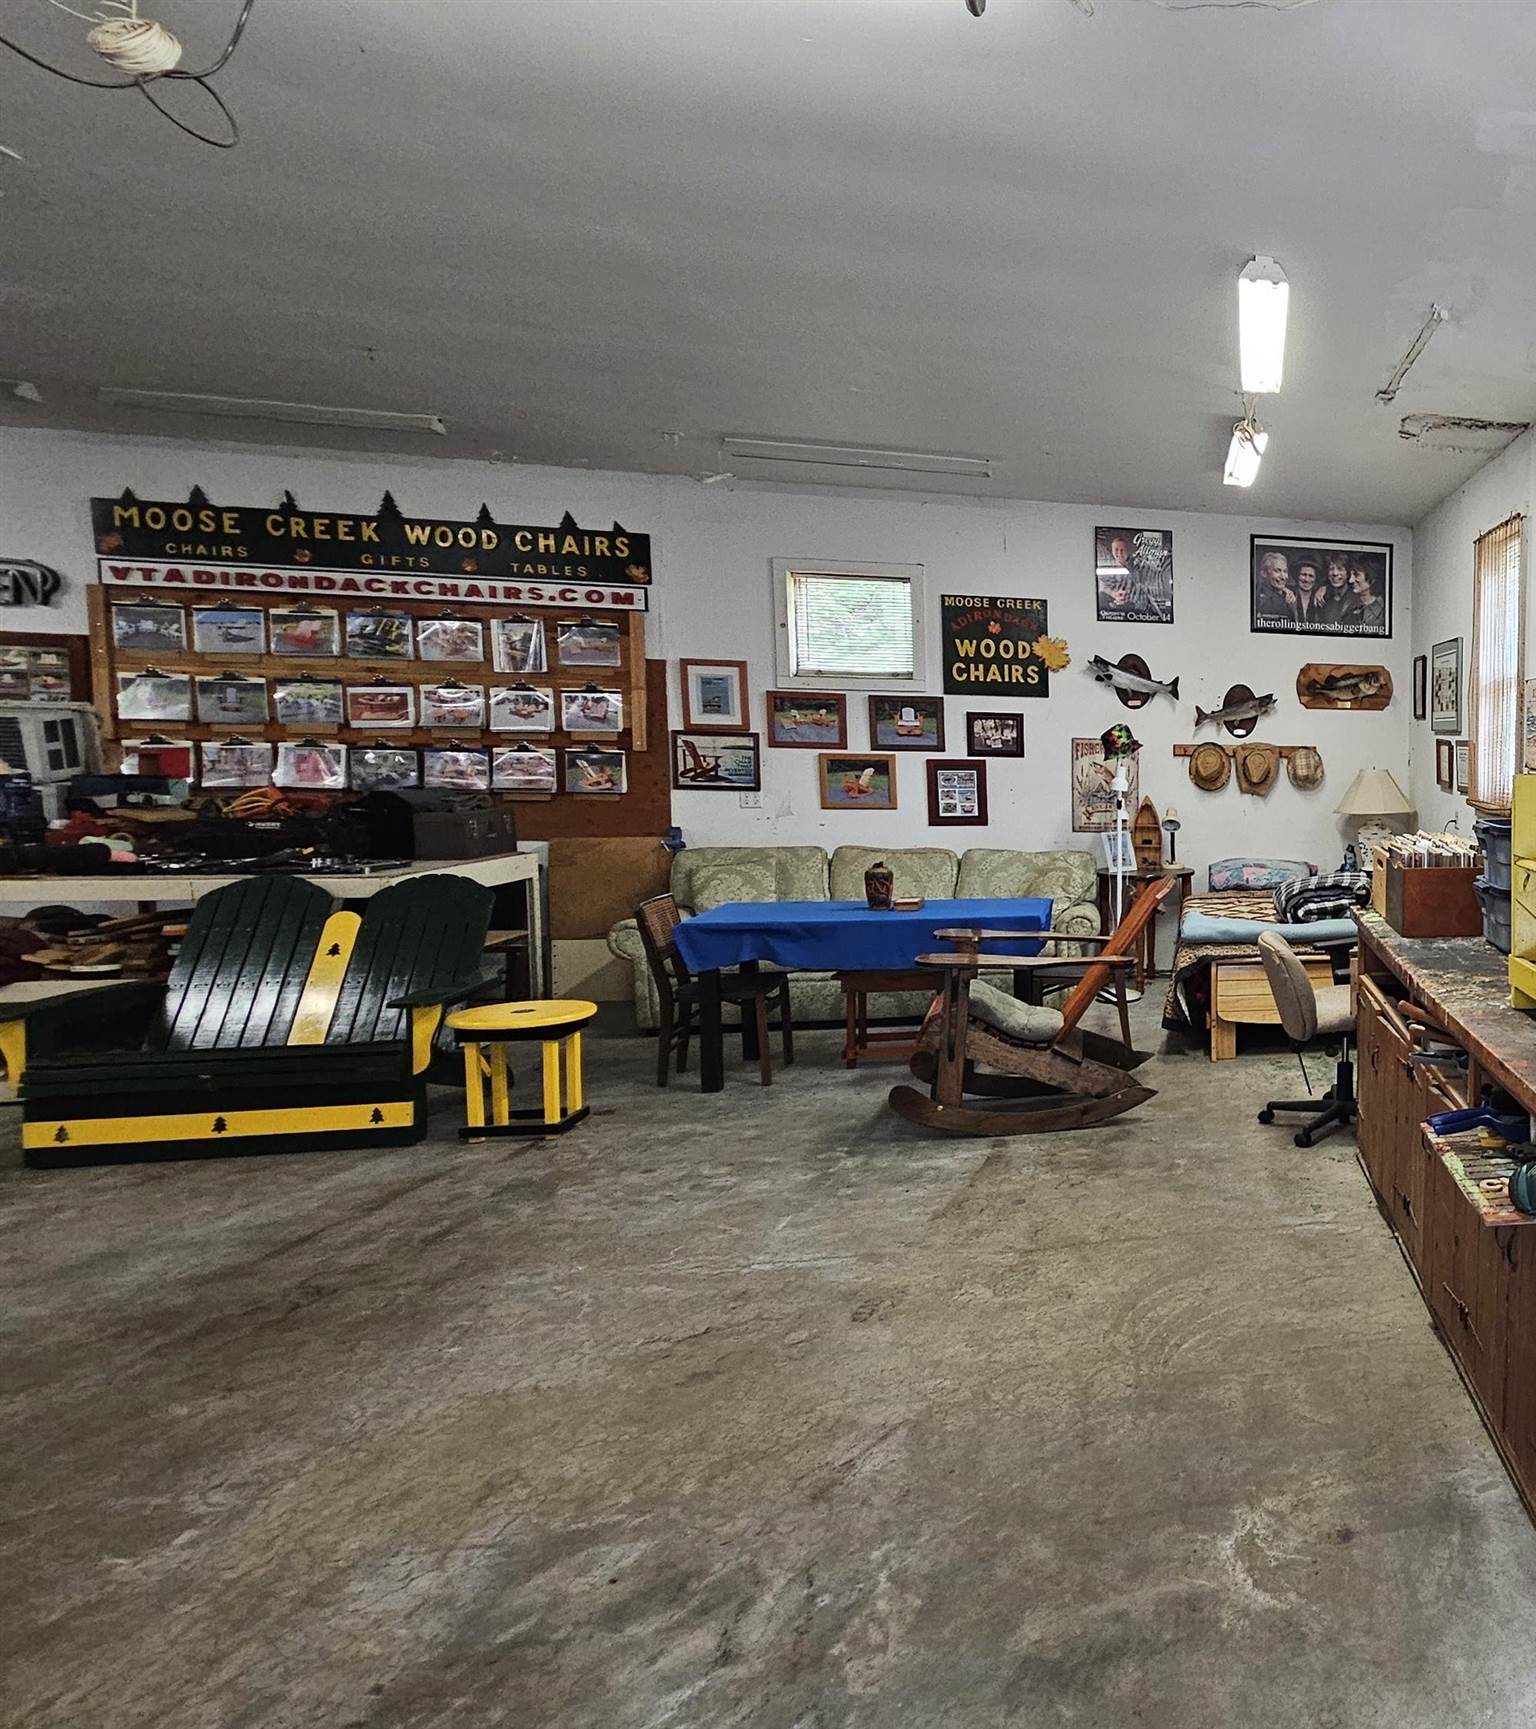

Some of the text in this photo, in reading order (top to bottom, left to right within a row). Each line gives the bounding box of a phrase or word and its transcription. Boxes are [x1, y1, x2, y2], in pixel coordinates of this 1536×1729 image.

[113, 505, 630, 558] MOOSE CREEK WOOD CHAIRS
[166, 543, 588, 577] CHAIRS GIFTS TABLES
[109, 566, 635, 605] VTADIRONDACKCHAIRS.COM
[944, 597, 1041, 609] MOOSE CREEK
[952, 609, 1040, 631] ADIRONDACK
[1127, 612, 1159, 620] October
[1257, 618, 1385, 634] therollingstonesabiggerbang
[955, 639, 1031, 659] WOOD
[952, 662, 1040, 684] CHAIRS
